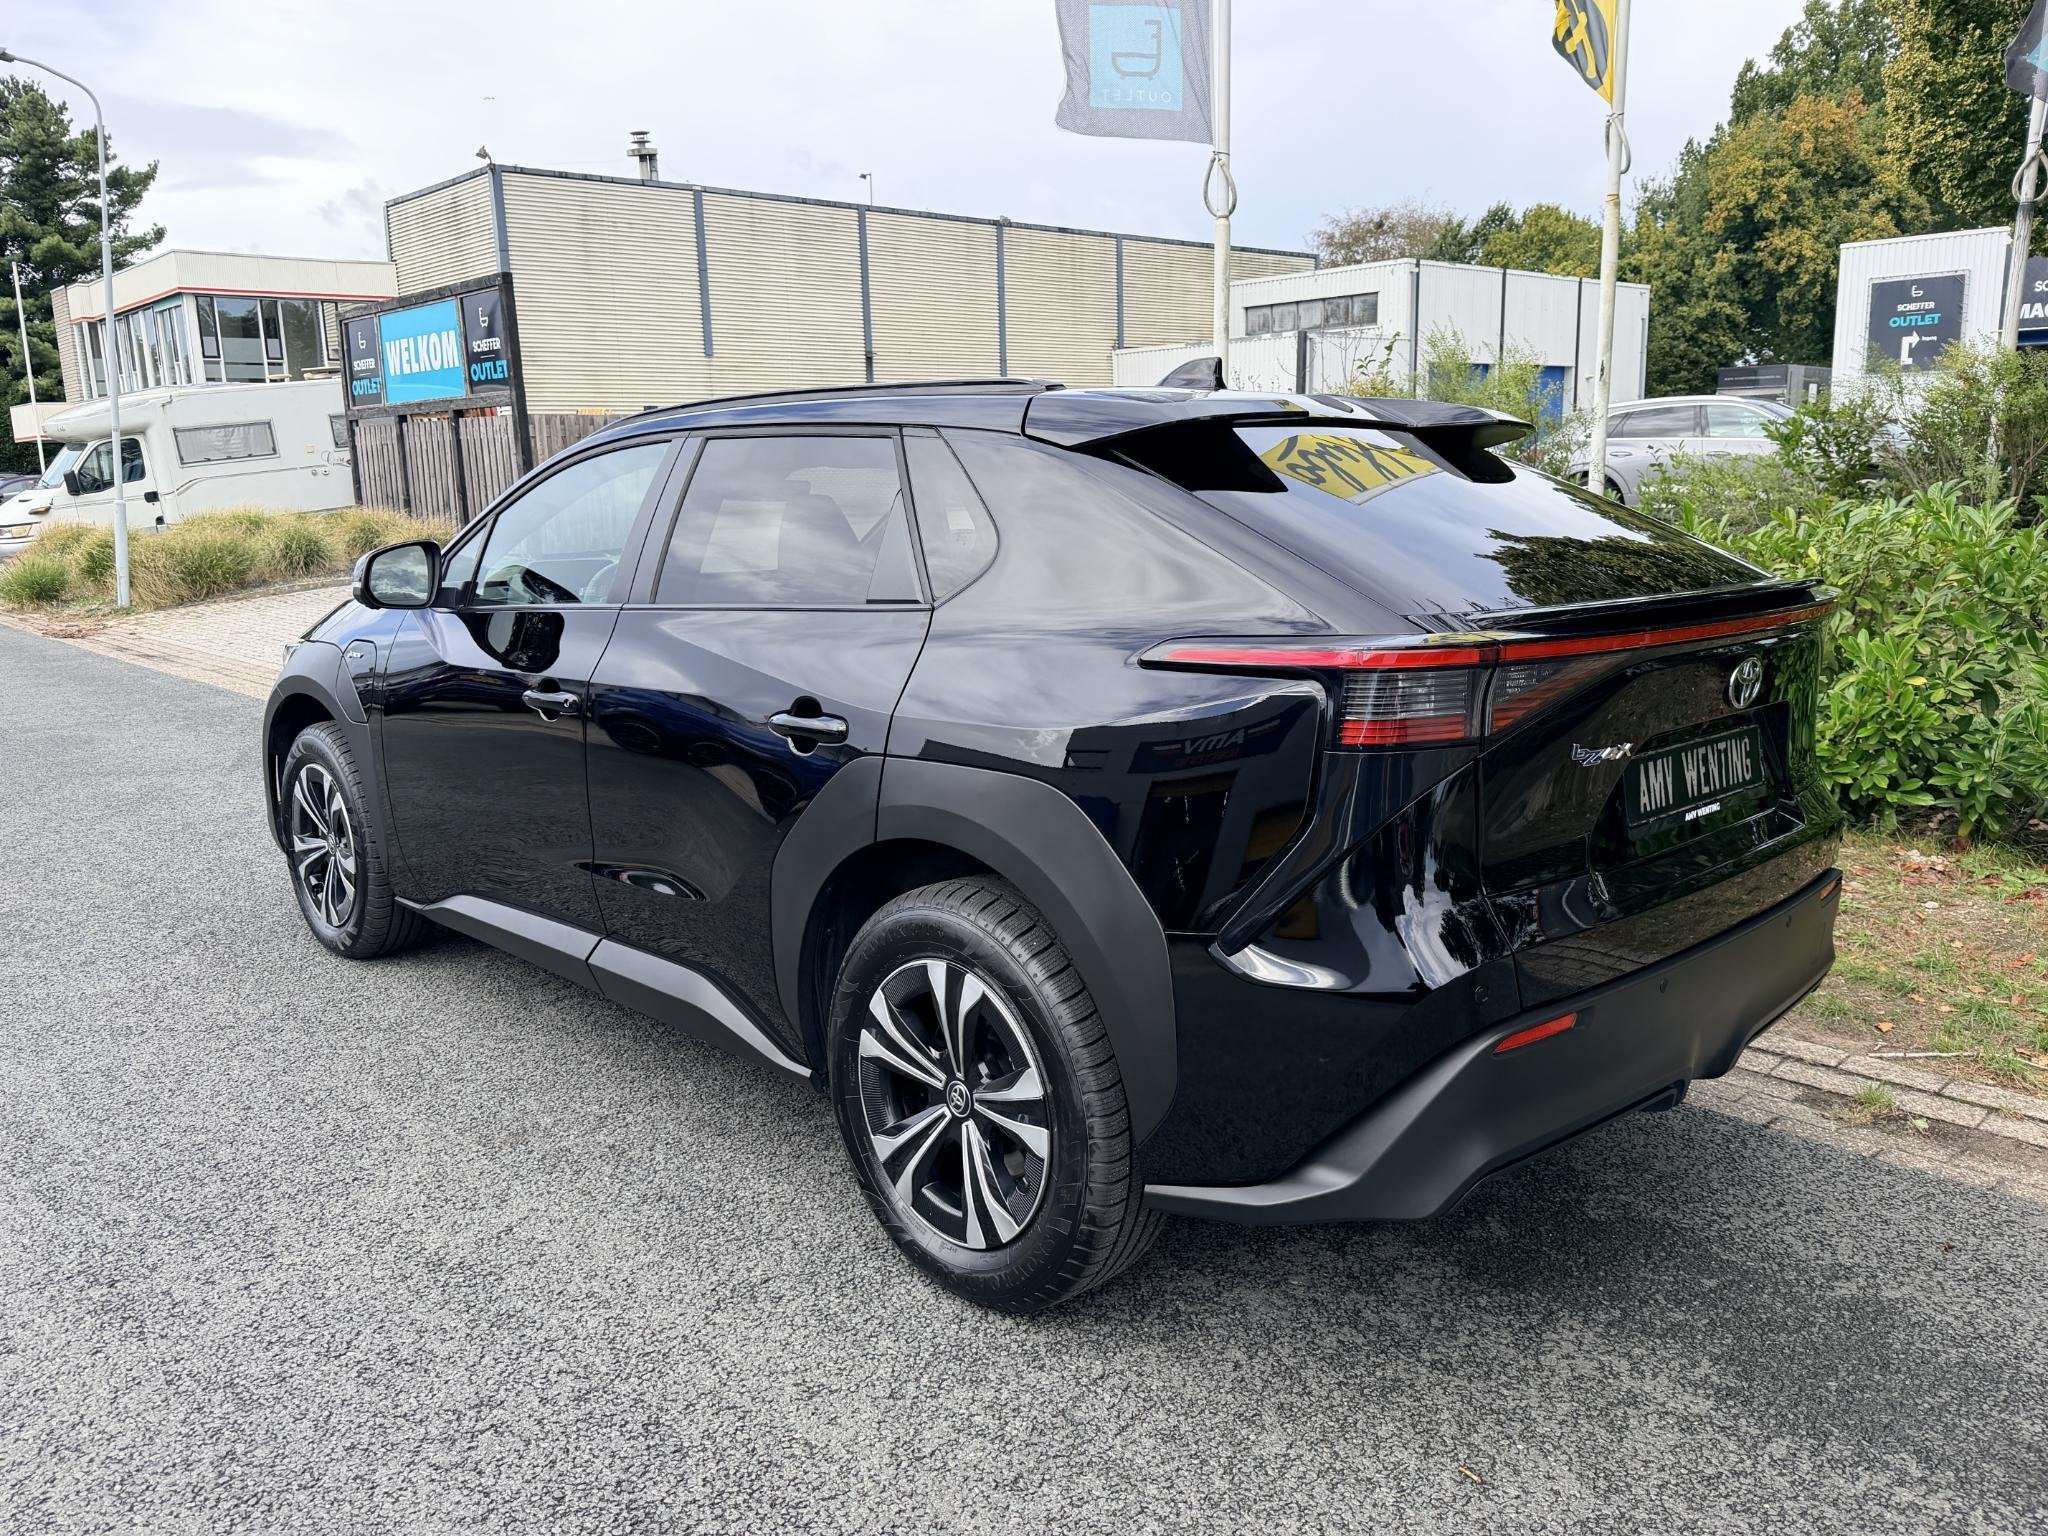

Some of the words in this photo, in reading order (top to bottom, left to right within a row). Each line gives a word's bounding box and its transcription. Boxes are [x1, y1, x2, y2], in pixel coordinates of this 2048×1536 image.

[1897, 301, 1935, 312] SCHEFFER
[1889, 313, 1941, 328] OUTLET
[385, 330, 459, 377] WELKOM
[472, 337, 501, 352] SCHEFFER
[471, 360, 509, 381] OUTLET
[352, 377, 381, 396] OUTLET
[1640, 755, 1673, 814] AMY
[1681, 736, 1752, 799] WENTING
[1684, 810, 1697, 822] AMY
[1697, 802, 1720, 817] WENTING
